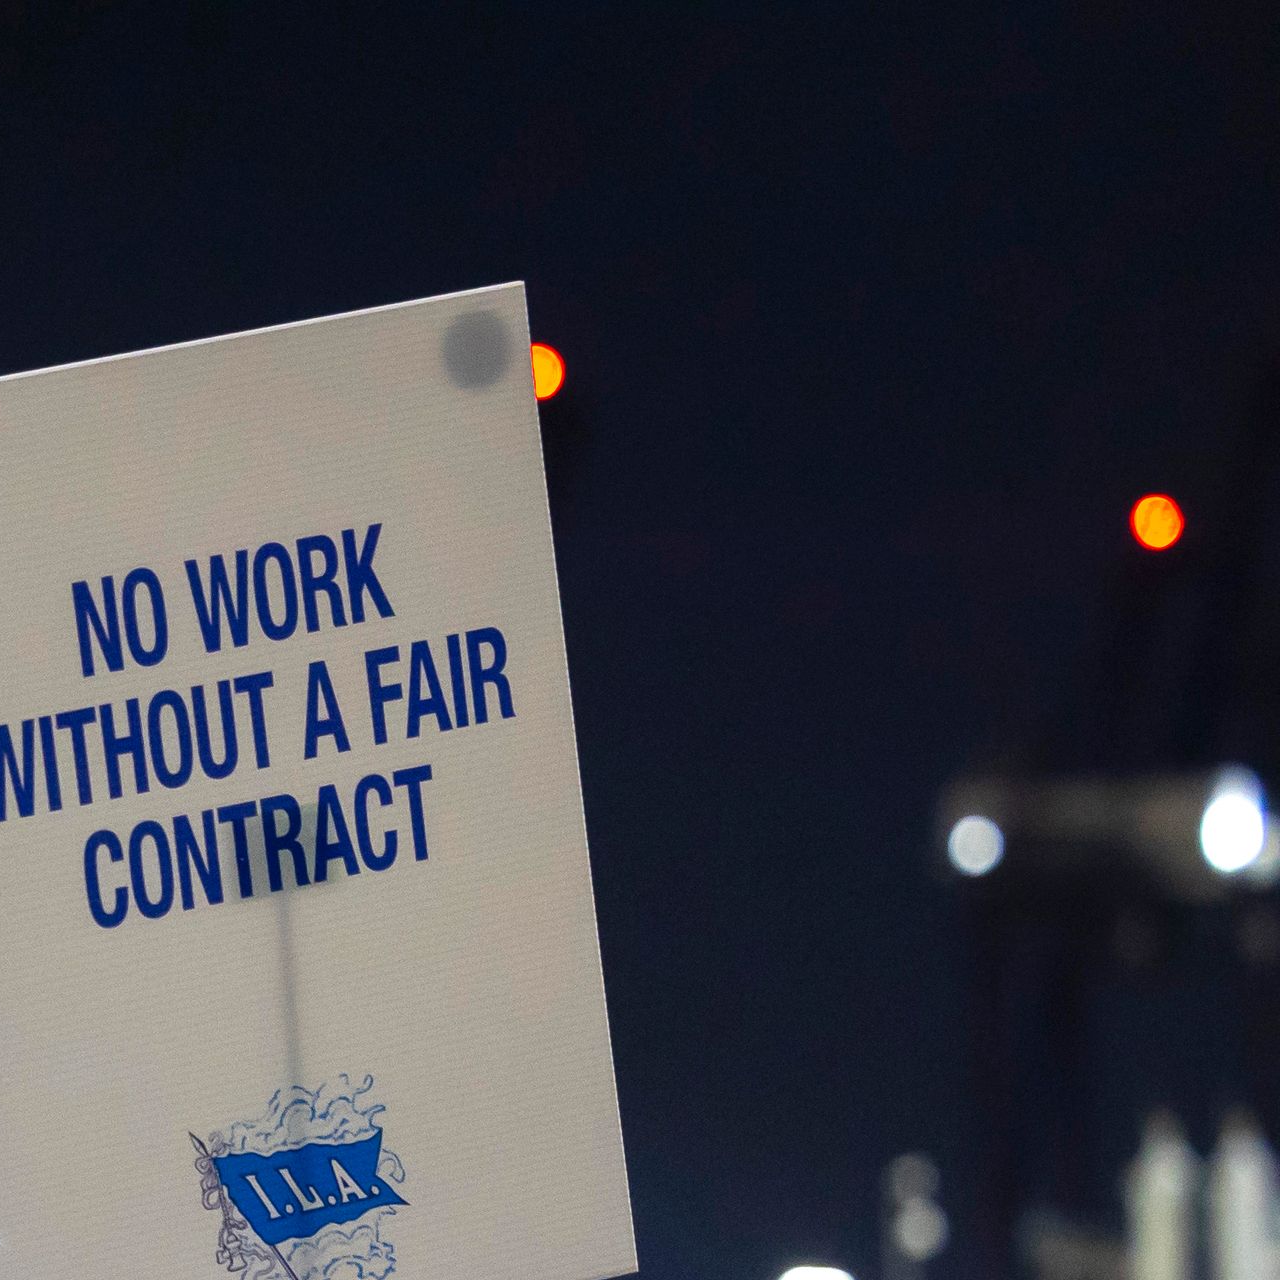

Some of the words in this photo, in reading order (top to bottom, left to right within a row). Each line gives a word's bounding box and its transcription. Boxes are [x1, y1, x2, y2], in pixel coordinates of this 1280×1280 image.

[71, 568, 169, 678] NO
[184, 523, 395, 653] WORK
[303, 661, 351, 760] A
[365, 626, 516, 745] FAIR
[83, 765, 433, 929] CONTRACT
[246, 1159, 380, 1219] I.L.A.
